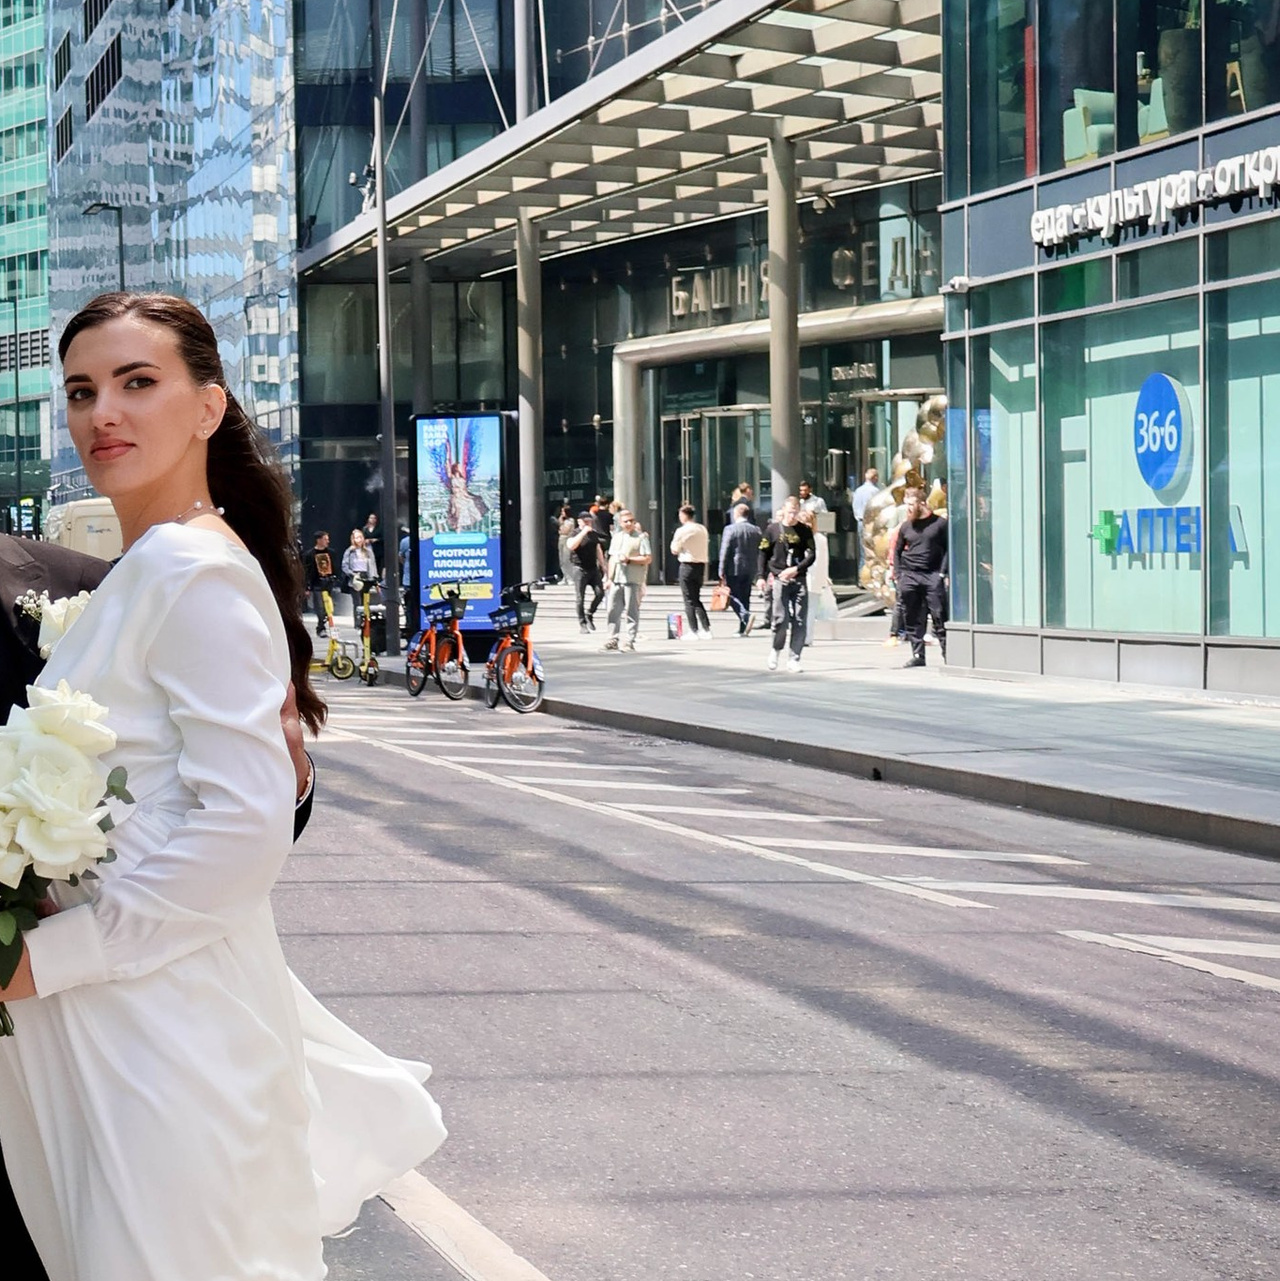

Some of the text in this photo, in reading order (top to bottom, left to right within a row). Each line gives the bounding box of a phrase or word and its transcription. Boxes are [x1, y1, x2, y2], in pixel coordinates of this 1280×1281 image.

[1031, 146, 1280, 247] еда культура откр
[671, 259, 770, 316] БАШНЯ
[432, 548, 488, 558] СМОТРОВАЯ
[1116, 506, 1238, 555] АПТЕ
[433, 559, 487, 569] ПЛОЩАДКА
